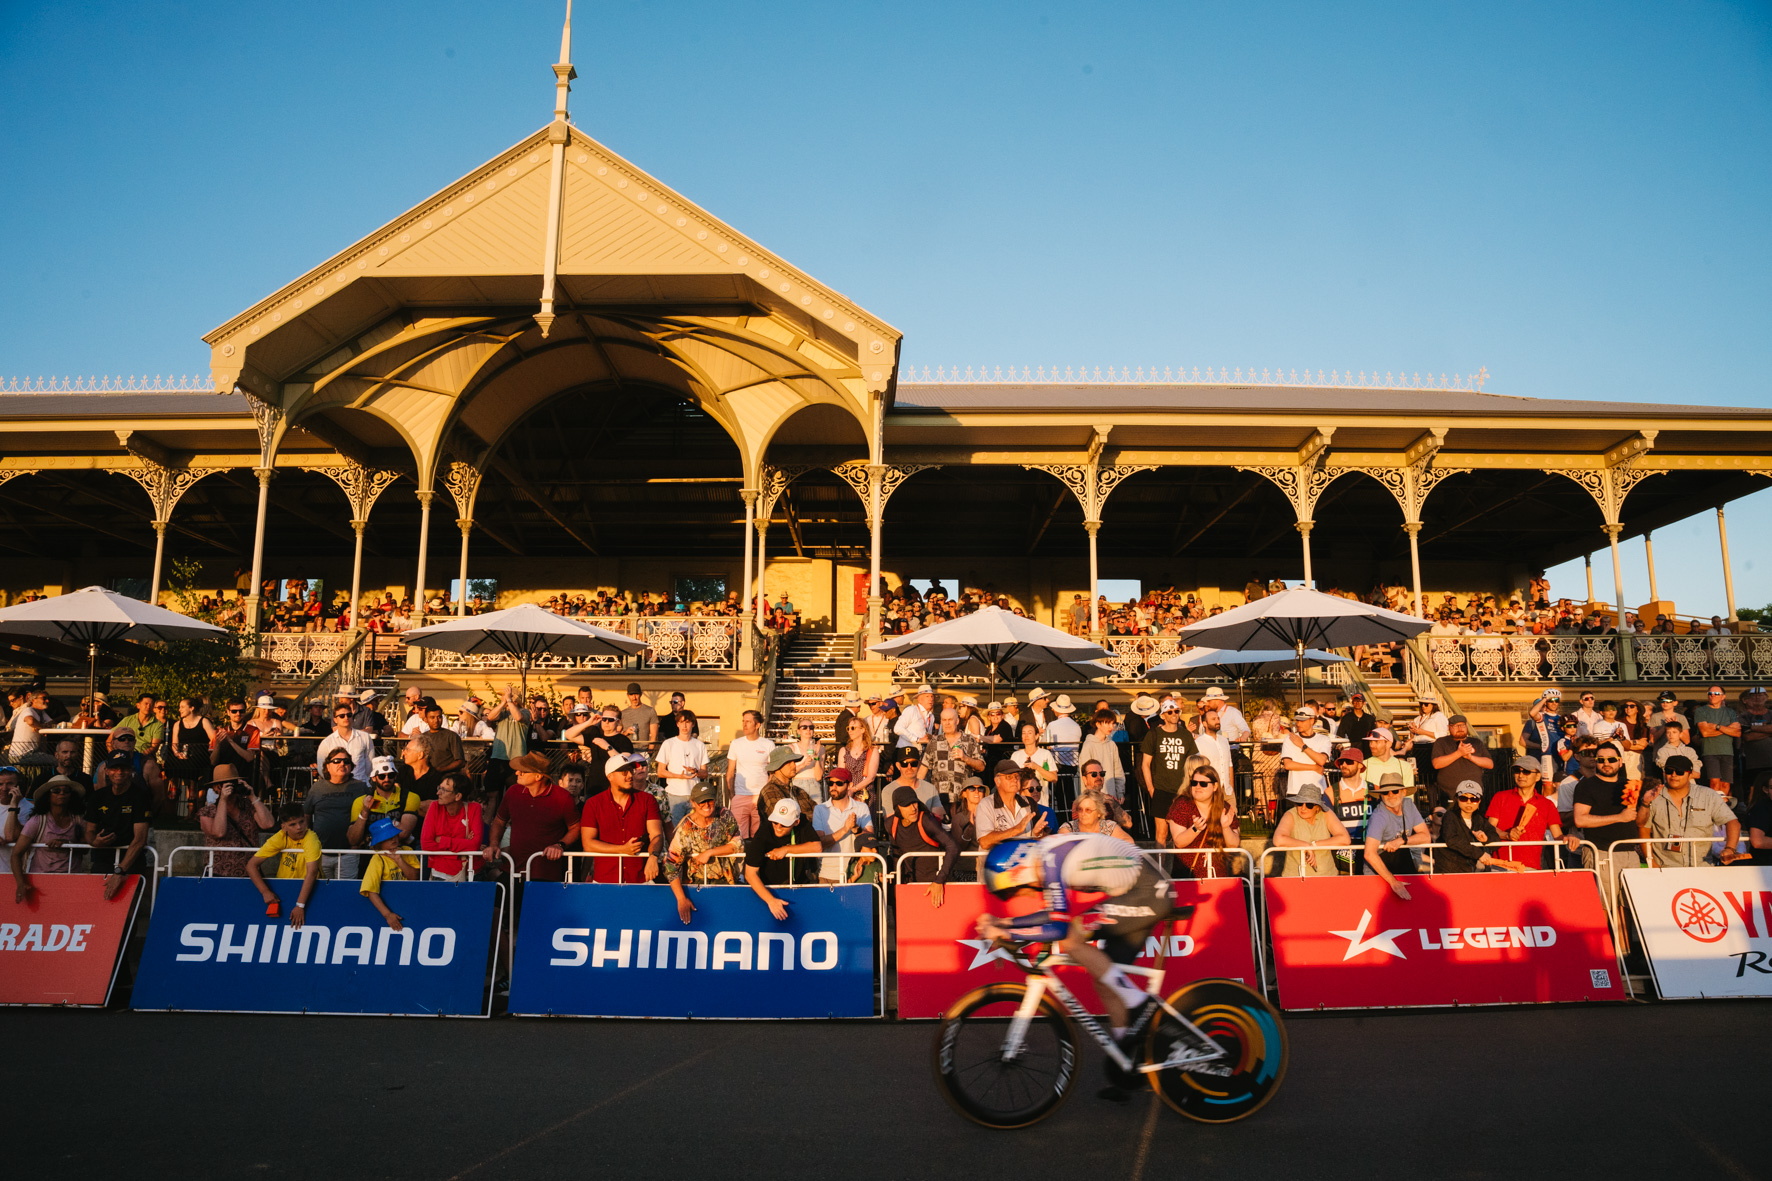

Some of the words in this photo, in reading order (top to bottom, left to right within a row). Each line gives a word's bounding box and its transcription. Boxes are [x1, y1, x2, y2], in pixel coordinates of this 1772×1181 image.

[1162, 737, 1183, 745] OK?
[1160, 745, 1185, 754] BIKE
[1165, 753, 1180, 761] MY
[1166, 761, 1178, 770] IS
[1342, 805, 1373, 817] POLO
[1418, 926, 1557, 950] LEGEND
[176, 923, 456, 966] SHIMANO
[550, 927, 839, 971] SHIMANO
[1728, 951, 1772, 978] R
